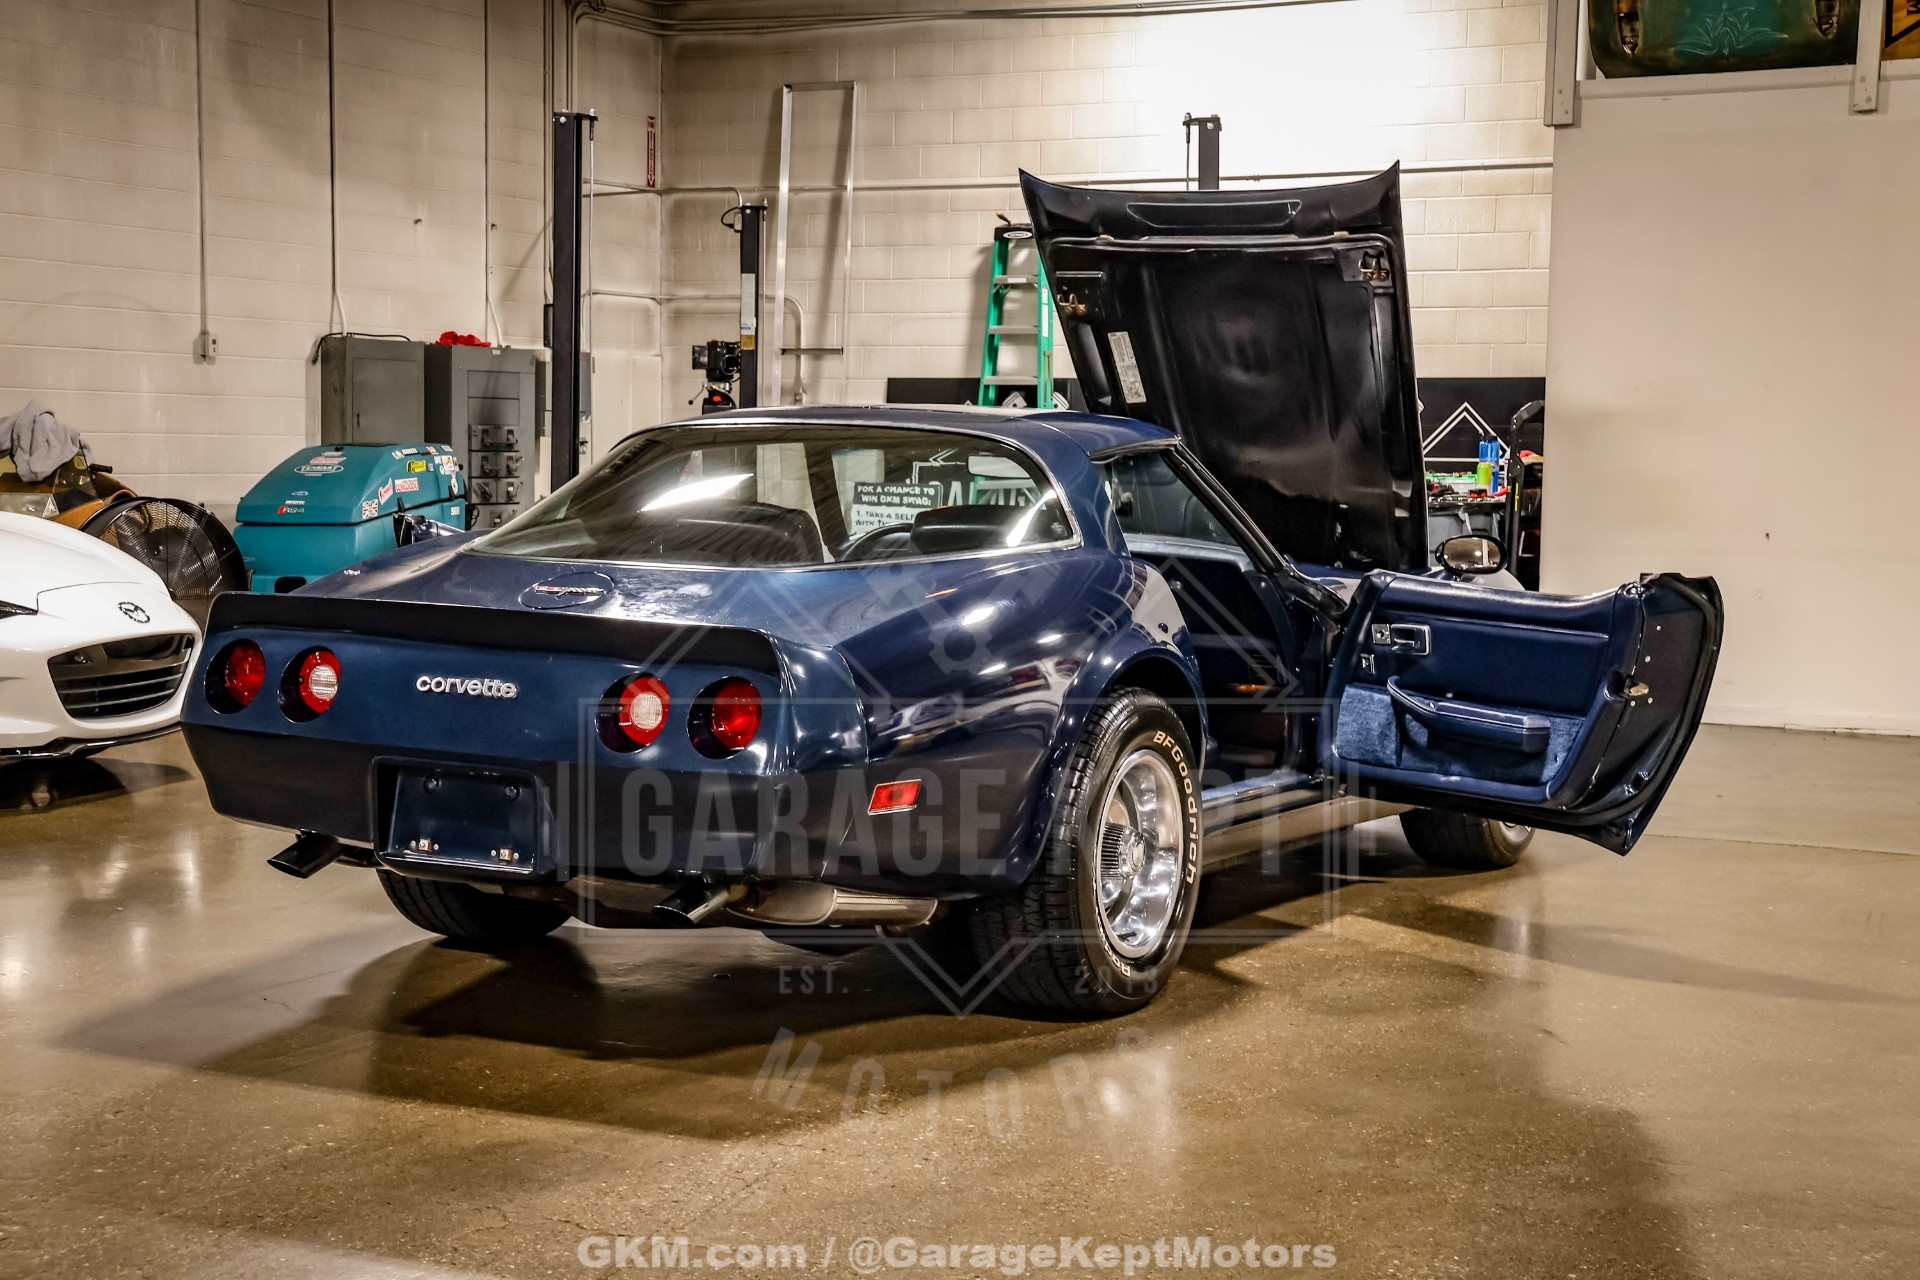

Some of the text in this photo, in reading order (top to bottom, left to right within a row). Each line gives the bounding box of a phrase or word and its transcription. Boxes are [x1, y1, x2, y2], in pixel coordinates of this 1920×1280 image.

[884, 486, 921, 495] CHANCE
[923, 487, 935, 496] TO
[861, 494, 932, 506] WIN GKM SWAG:
[895, 512, 915, 521] SELF
[416, 675, 518, 698] corvette
[1153, 730, 1199, 885] BFGoodrich
